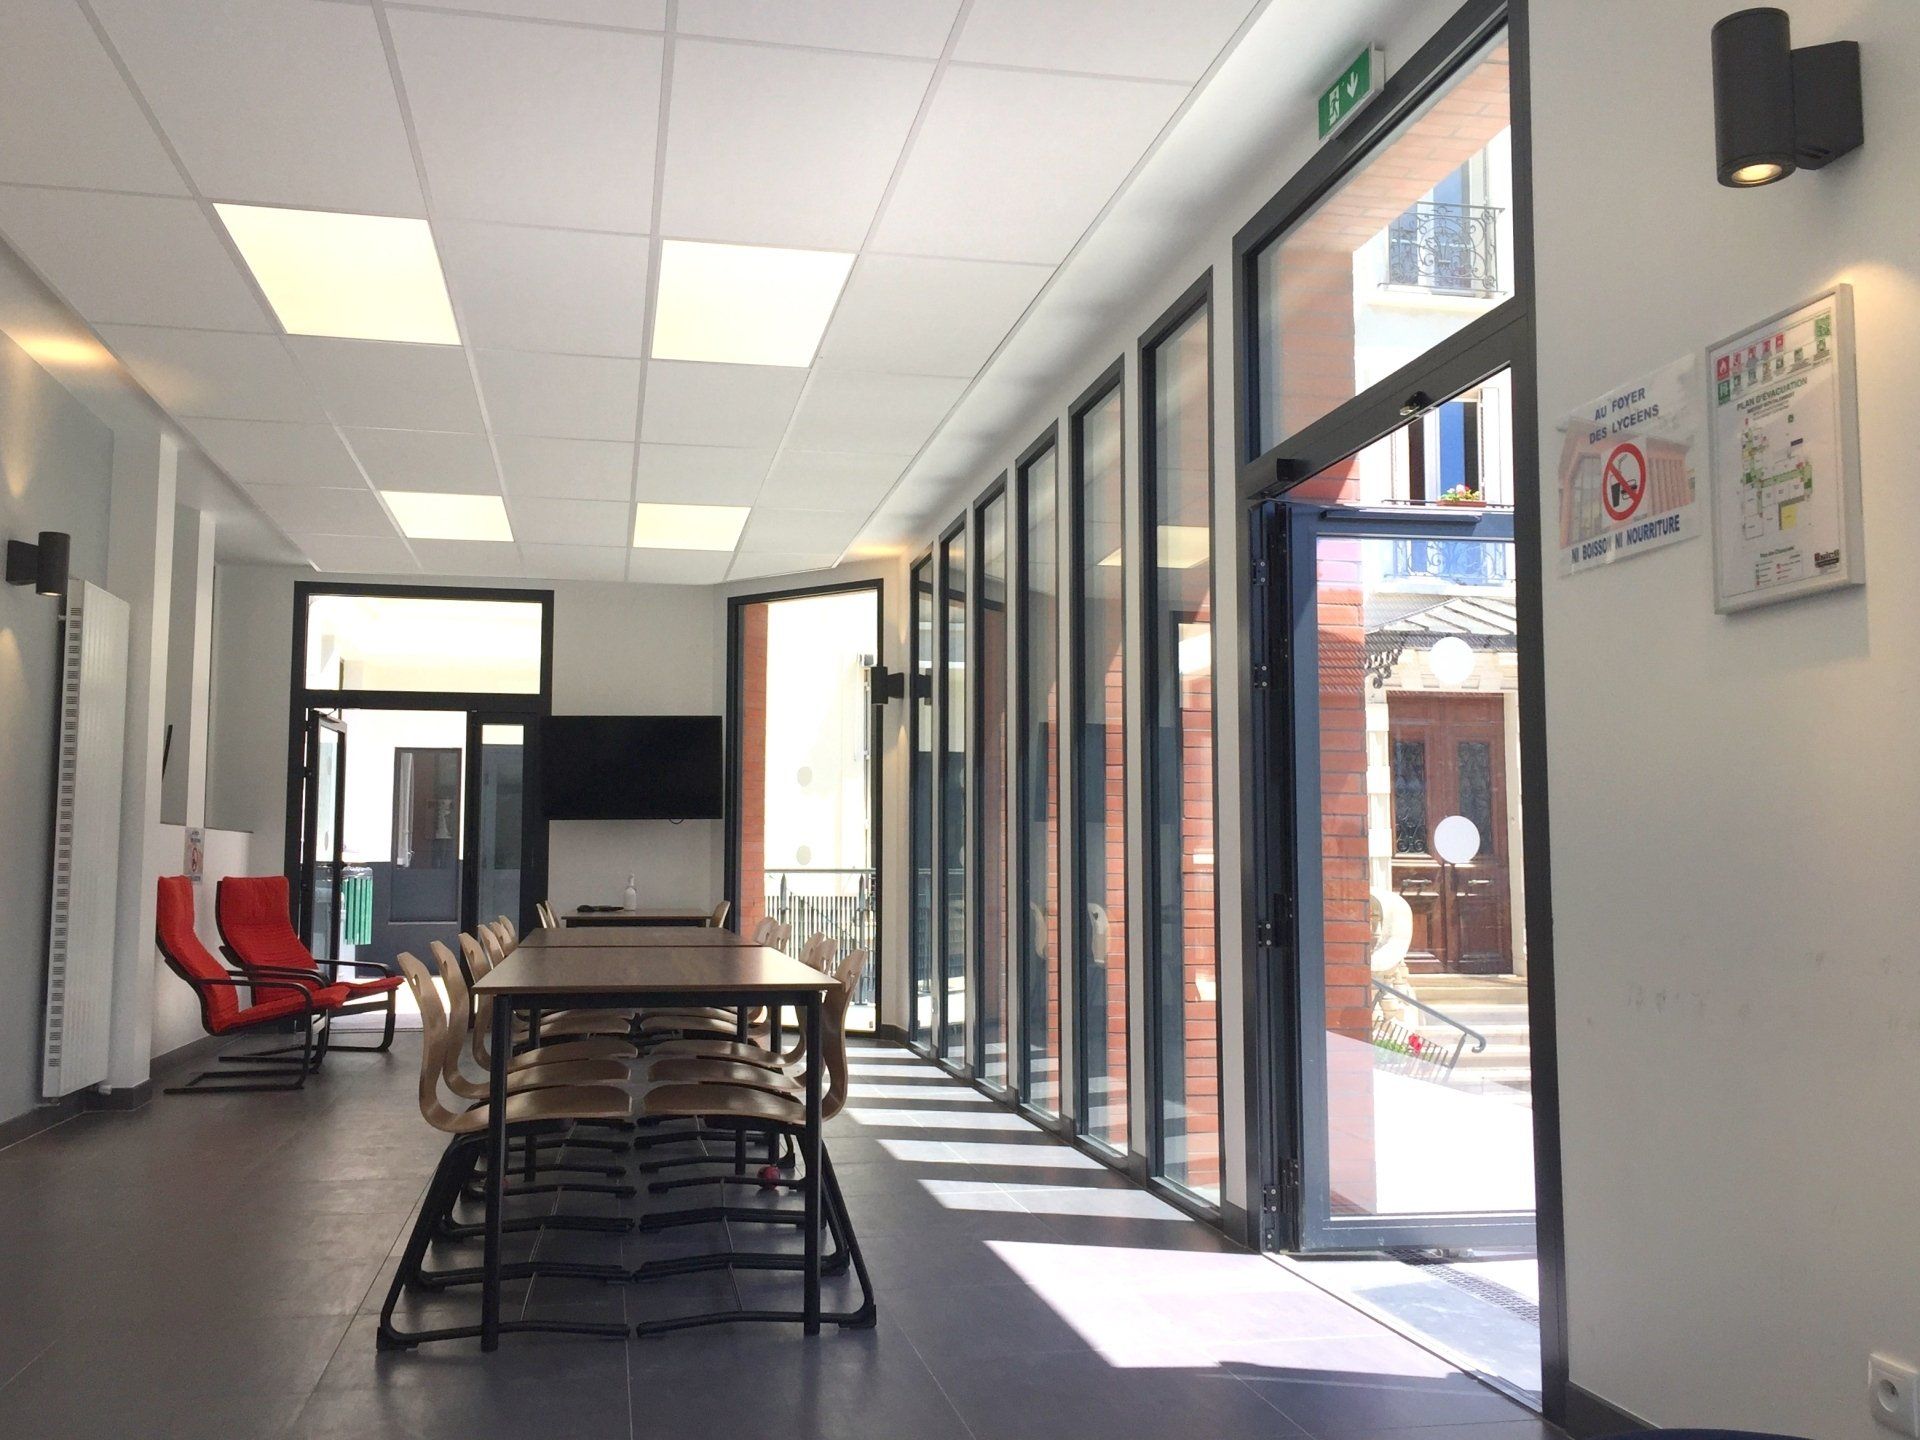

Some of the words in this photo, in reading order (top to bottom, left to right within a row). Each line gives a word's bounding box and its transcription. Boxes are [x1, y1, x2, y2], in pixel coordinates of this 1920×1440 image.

[1594, 405, 1607, 421] AU
[1612, 387, 1645, 413] FOYER
[1737, 396, 1756, 411] PLAN
[1589, 426, 1607, 445] DES
[1612, 404, 1660, 434] LYCEENS
[1571, 548, 1579, 563] NI
[1615, 532, 1623, 549] NI
[1626, 514, 1680, 544] NOURRITURE
